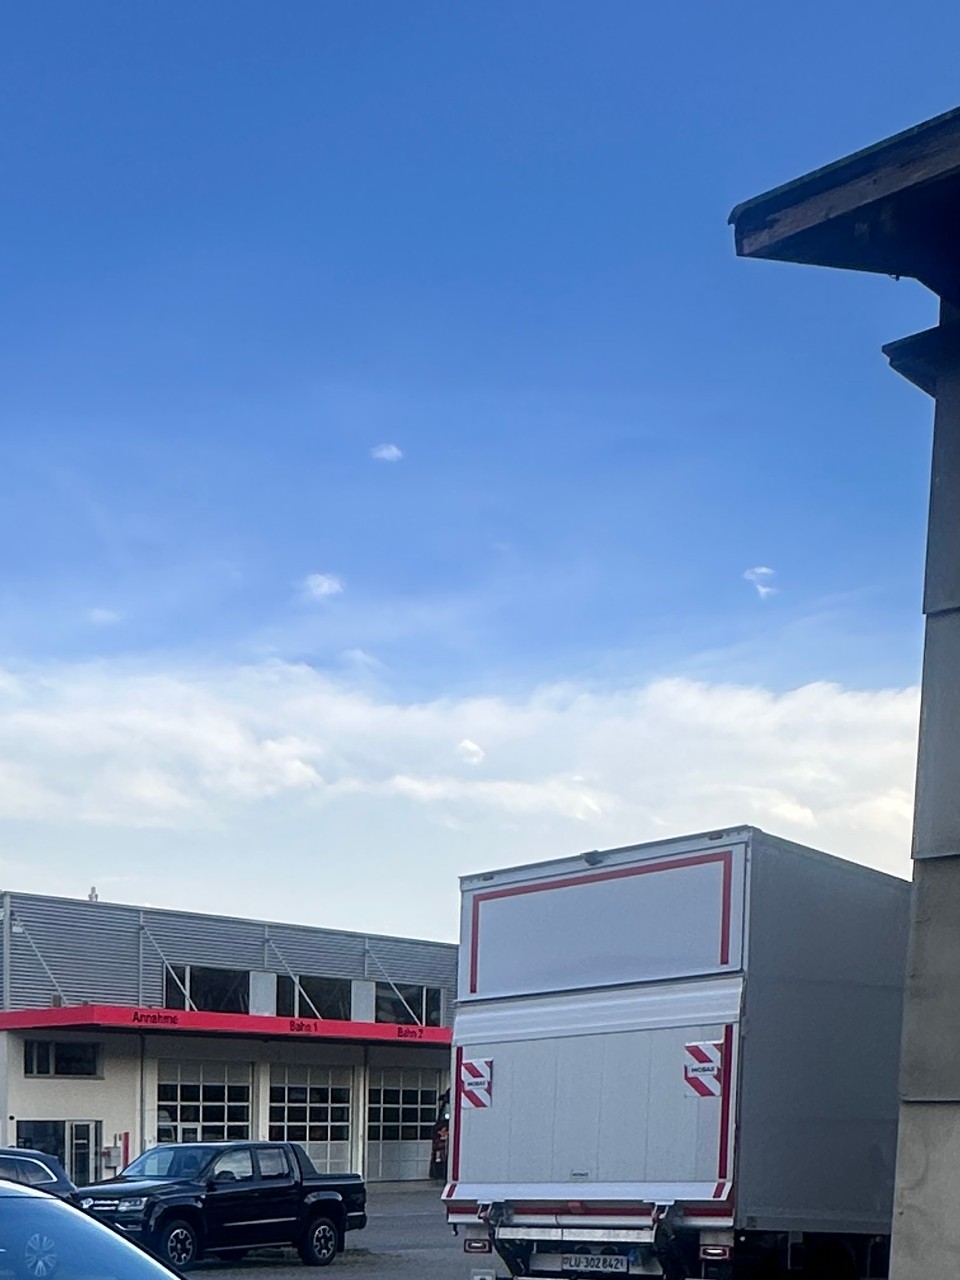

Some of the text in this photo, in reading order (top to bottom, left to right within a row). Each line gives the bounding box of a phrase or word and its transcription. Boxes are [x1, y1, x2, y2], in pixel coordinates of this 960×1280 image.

[132, 1011, 178, 1025] Annahme
[289, 1020, 318, 1032] Bahn 1
[397, 1026, 424, 1039] Bahn 2
